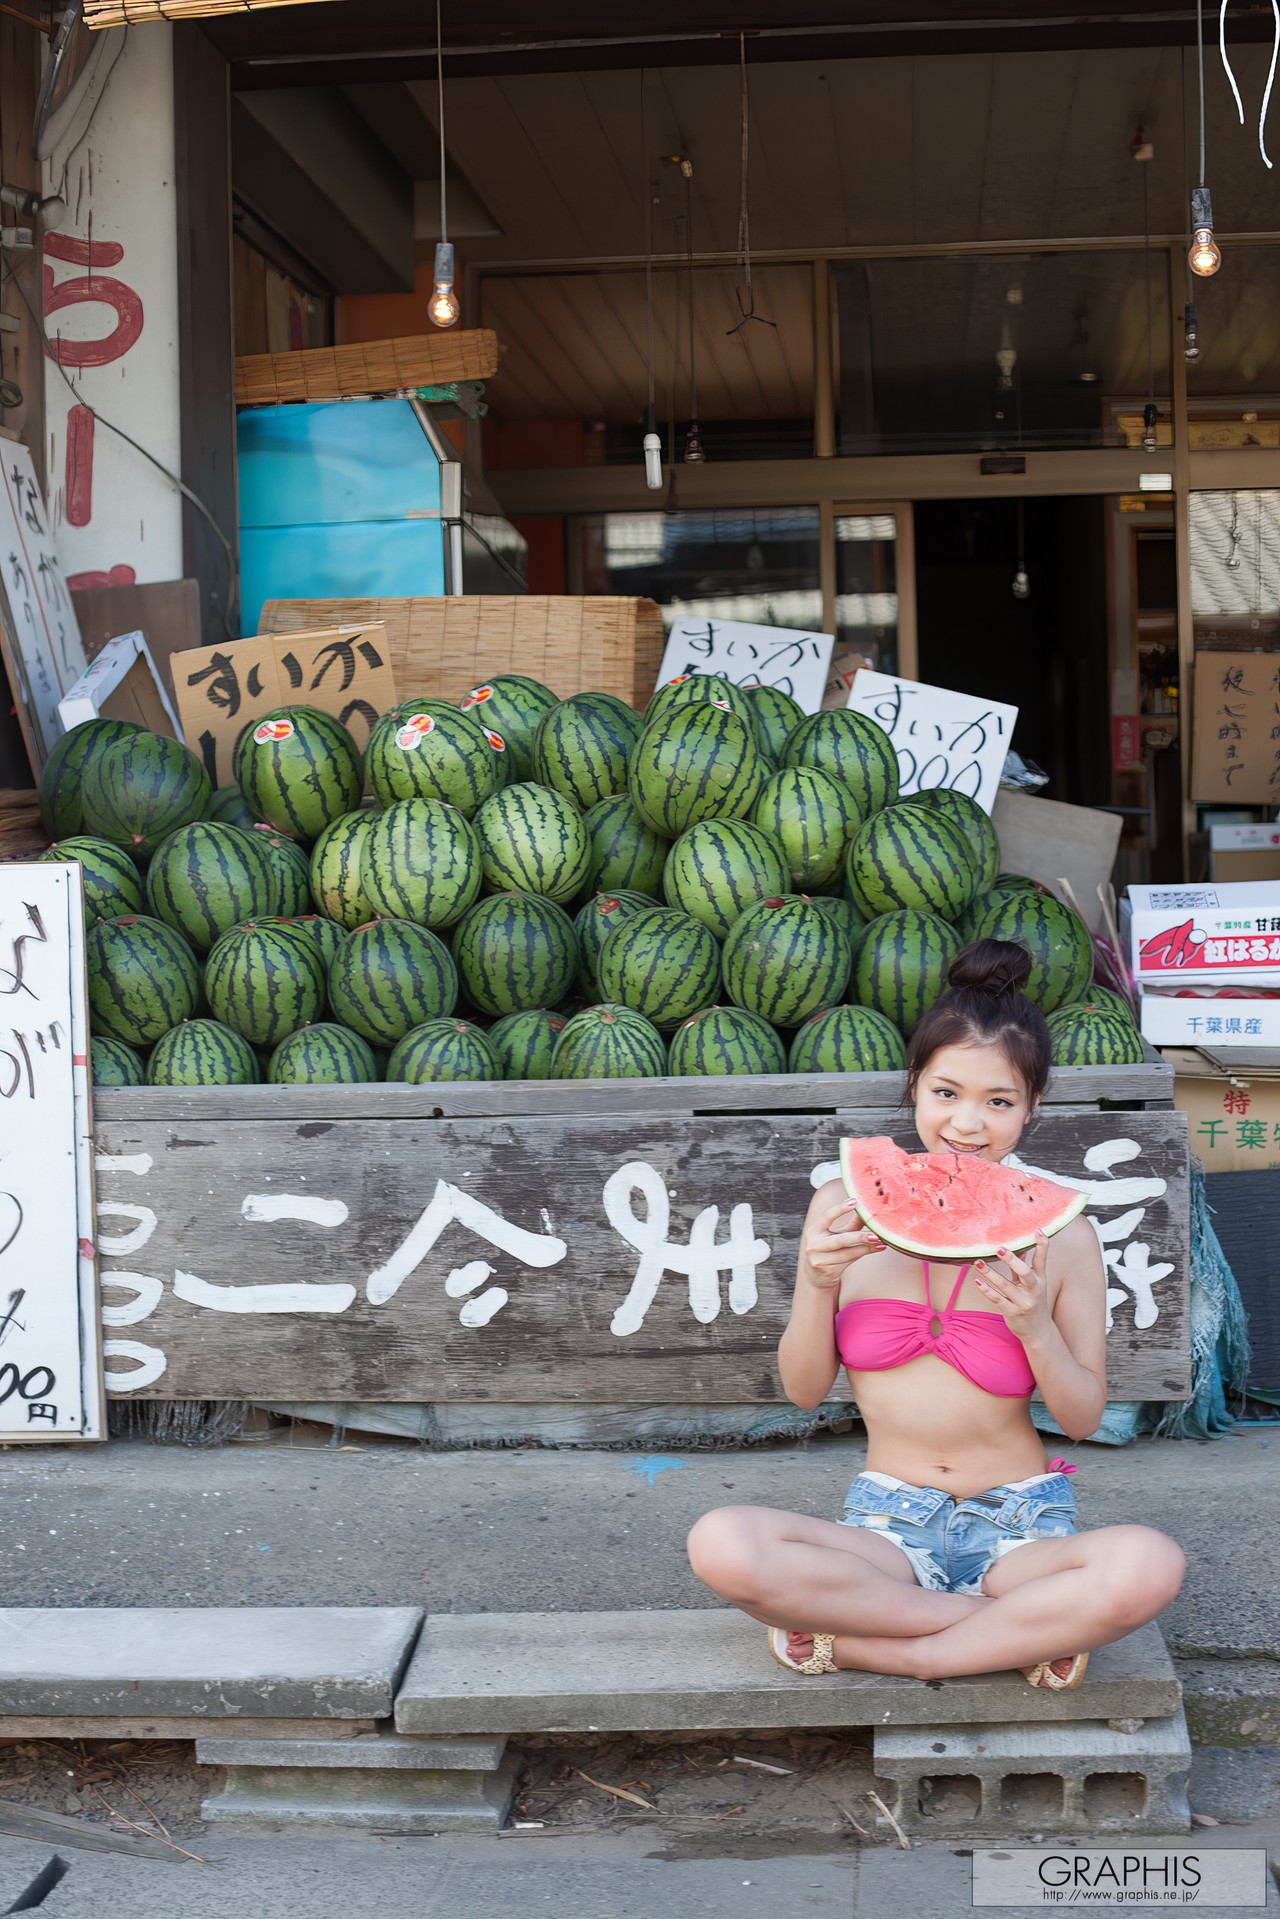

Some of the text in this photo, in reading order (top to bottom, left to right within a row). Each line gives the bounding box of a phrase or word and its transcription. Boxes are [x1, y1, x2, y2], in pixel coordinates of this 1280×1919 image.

[682, 622, 821, 669] すいか
[187, 634, 384, 719] すいか
[862, 684, 1003, 753] すいか
[1187, 1017, 1262, 1034] 千葉県産
[1223, 1089, 1251, 1115] 特
[1197, 1119, 1280, 1150] 千葉
